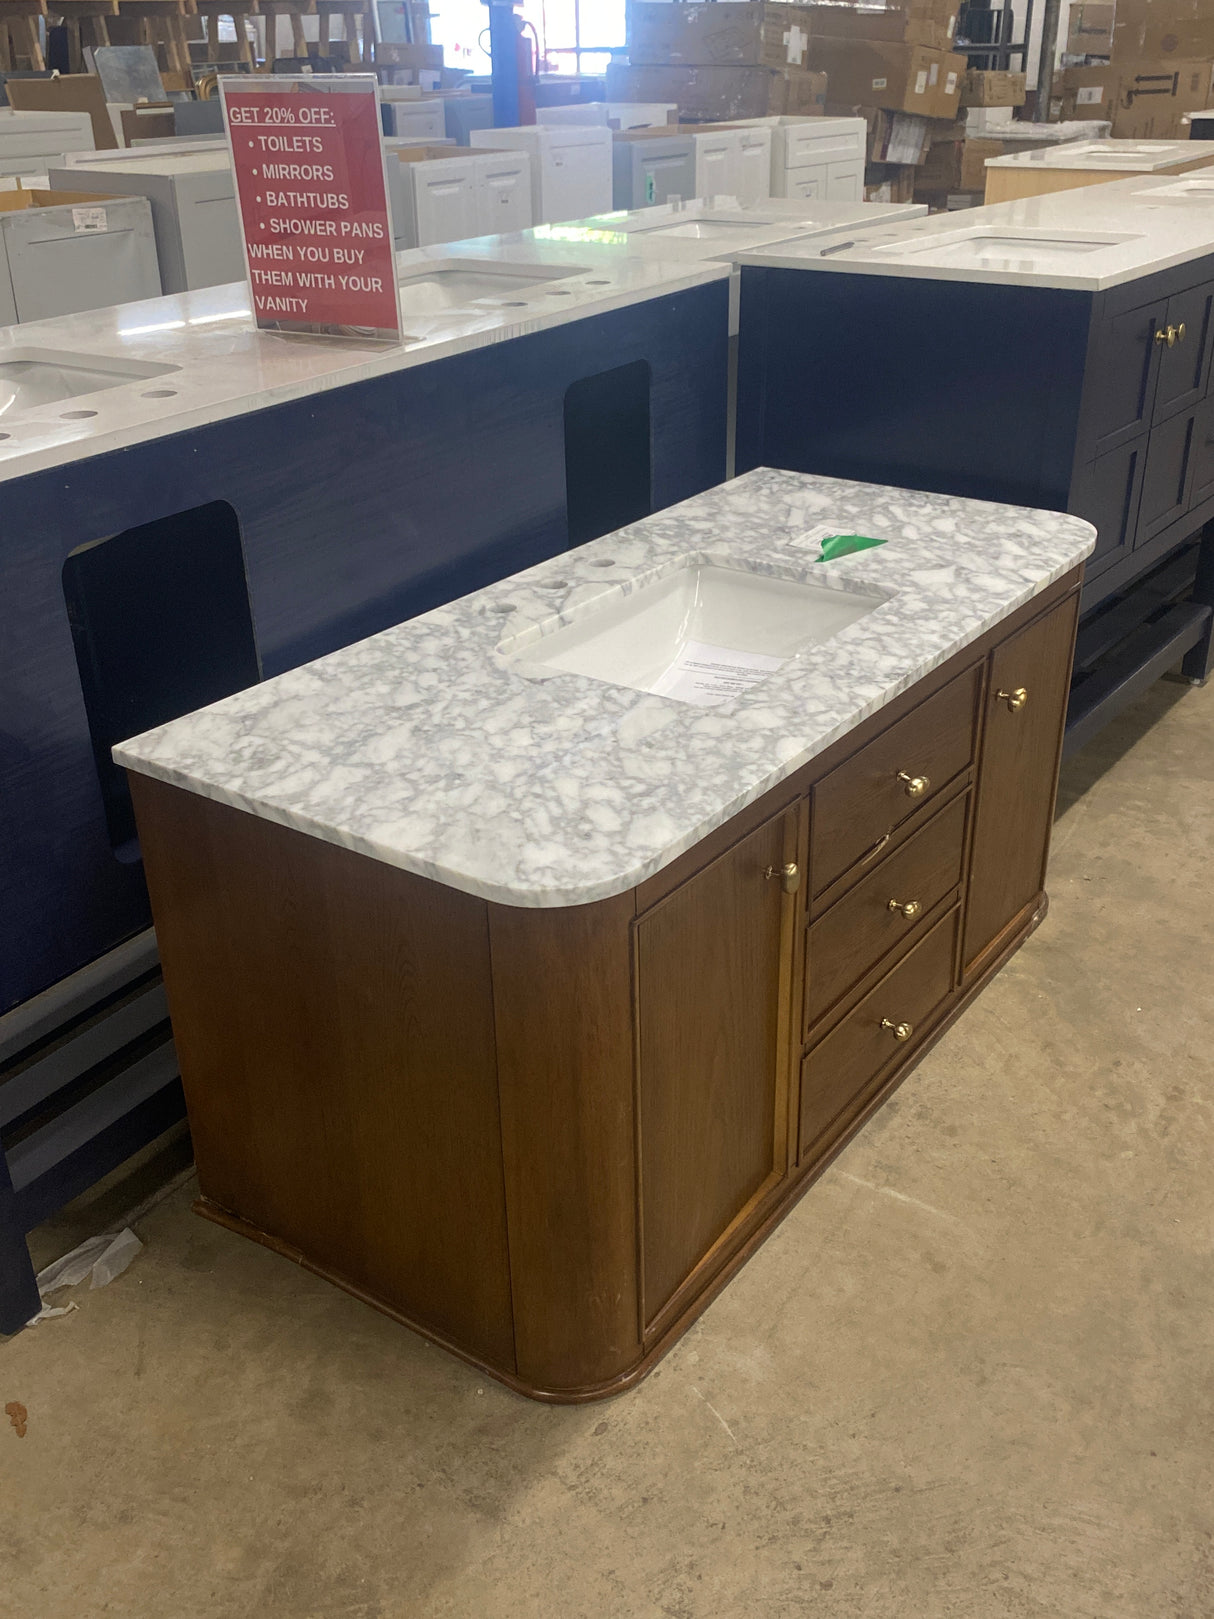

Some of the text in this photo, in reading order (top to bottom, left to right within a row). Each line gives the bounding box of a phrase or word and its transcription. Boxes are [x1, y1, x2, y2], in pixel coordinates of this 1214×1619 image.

[230, 107, 335, 124] GET 20% OFF:
[258, 135, 323, 152] TOILETS
[262, 163, 334, 181] MIRRORS
[266, 191, 349, 209] BATHTUBS
[270, 218, 384, 238] SHOWER PANS
[249, 243, 364, 264] WHEN YOU BUY
[252, 269, 383, 293] THEM WITH YOUR
[256, 296, 308, 313] VANITY
